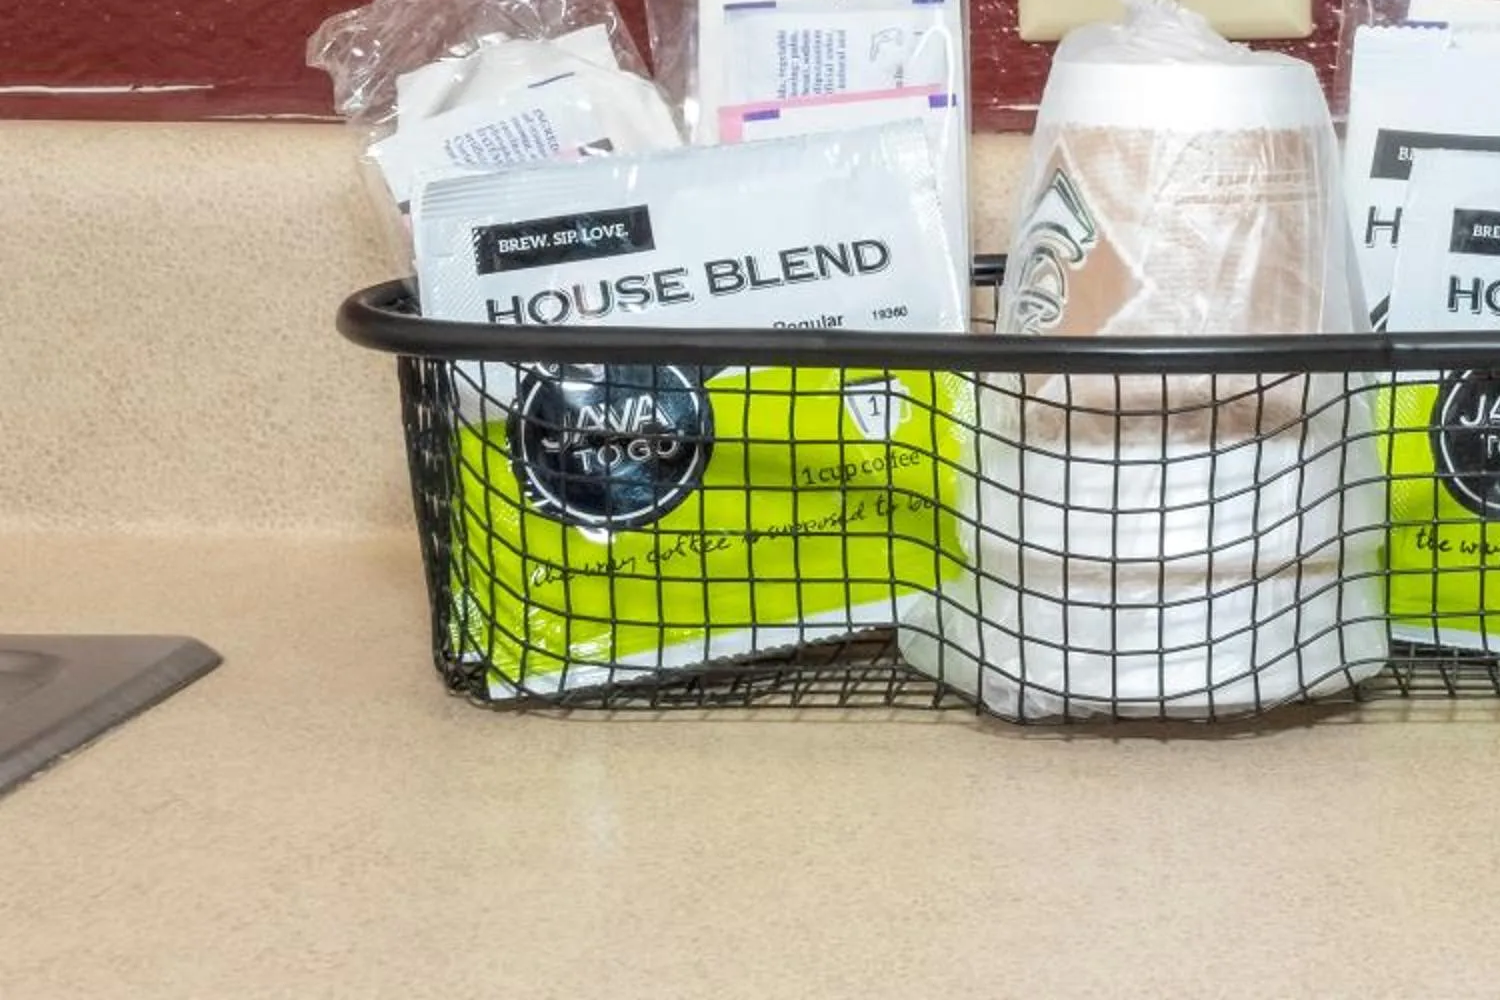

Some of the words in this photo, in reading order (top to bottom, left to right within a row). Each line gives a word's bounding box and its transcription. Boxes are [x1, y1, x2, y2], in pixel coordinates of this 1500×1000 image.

[498, 233, 551, 253] BREW.
[553, 230, 579, 246] SIP.
[583, 223, 629, 242] LOVE.
[485, 267, 694, 324] HOUSE
[704, 238, 892, 297] BLEND
[541, 393, 676, 448] JAVA
[868, 395, 881, 417] 1
[802, 468, 816, 485] 1
[819, 462, 857, 483] cup
[861, 450, 921, 474] cofee
